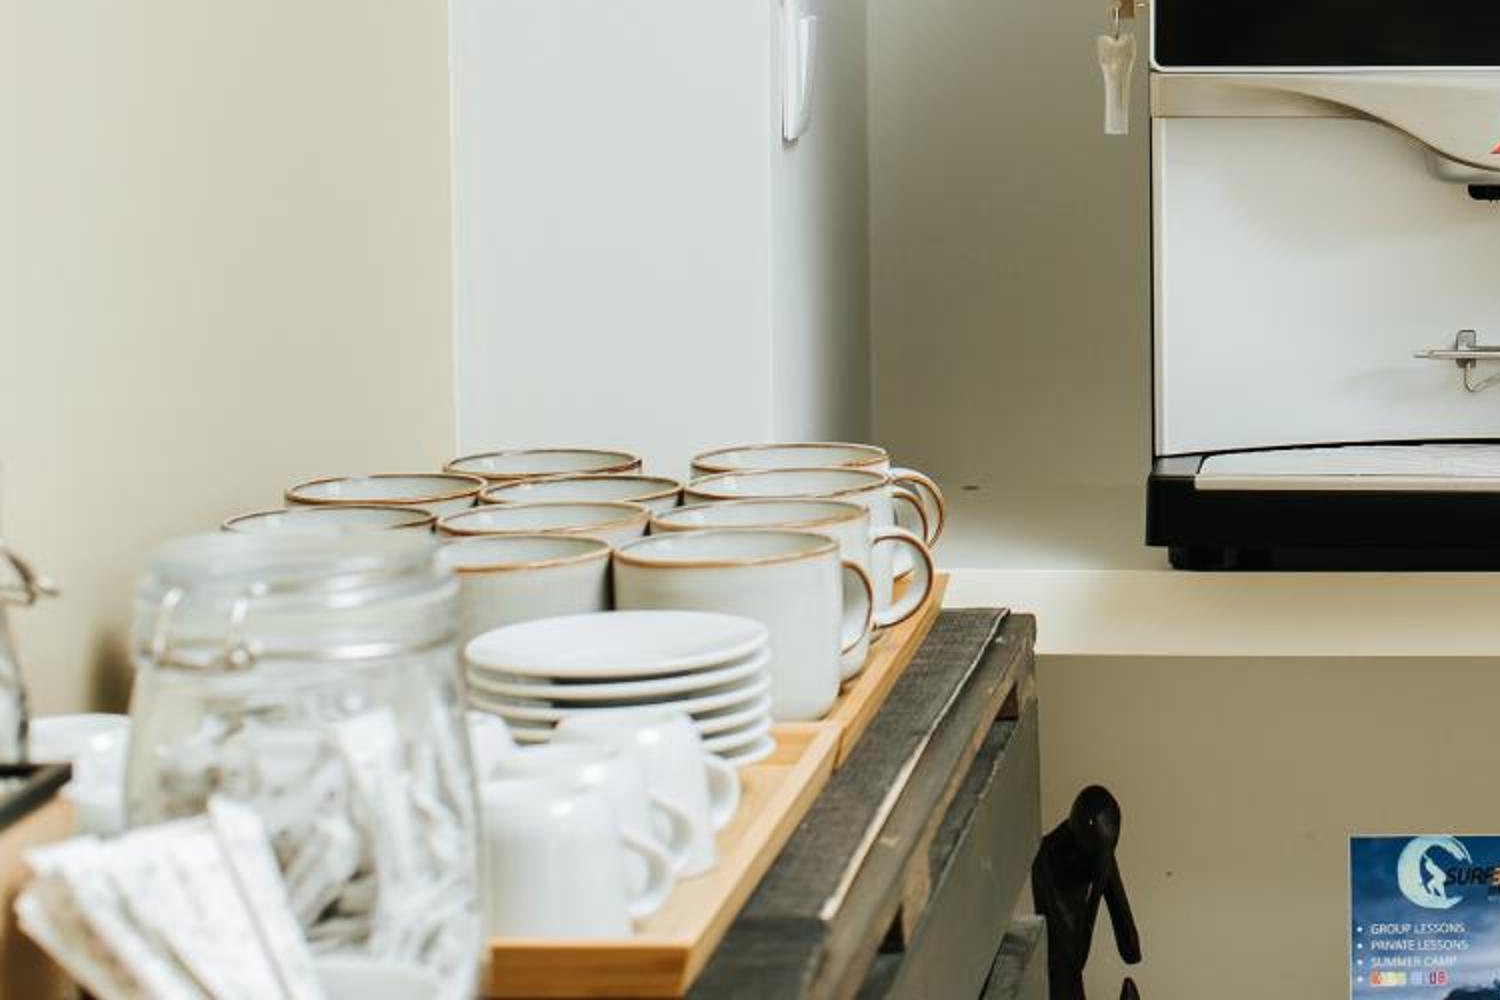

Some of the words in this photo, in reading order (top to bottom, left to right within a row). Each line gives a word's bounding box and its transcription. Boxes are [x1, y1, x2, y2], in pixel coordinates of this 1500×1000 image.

[1371, 923, 1410, 935] GROUP
[1413, 923, 1465, 934] LESSONS
[1371, 939, 1415, 951] PRIVATE
[1417, 939, 1469, 951] LESSONS
[1371, 956, 1421, 967] SUMMER
[1423, 955, 1457, 967] CAMP
